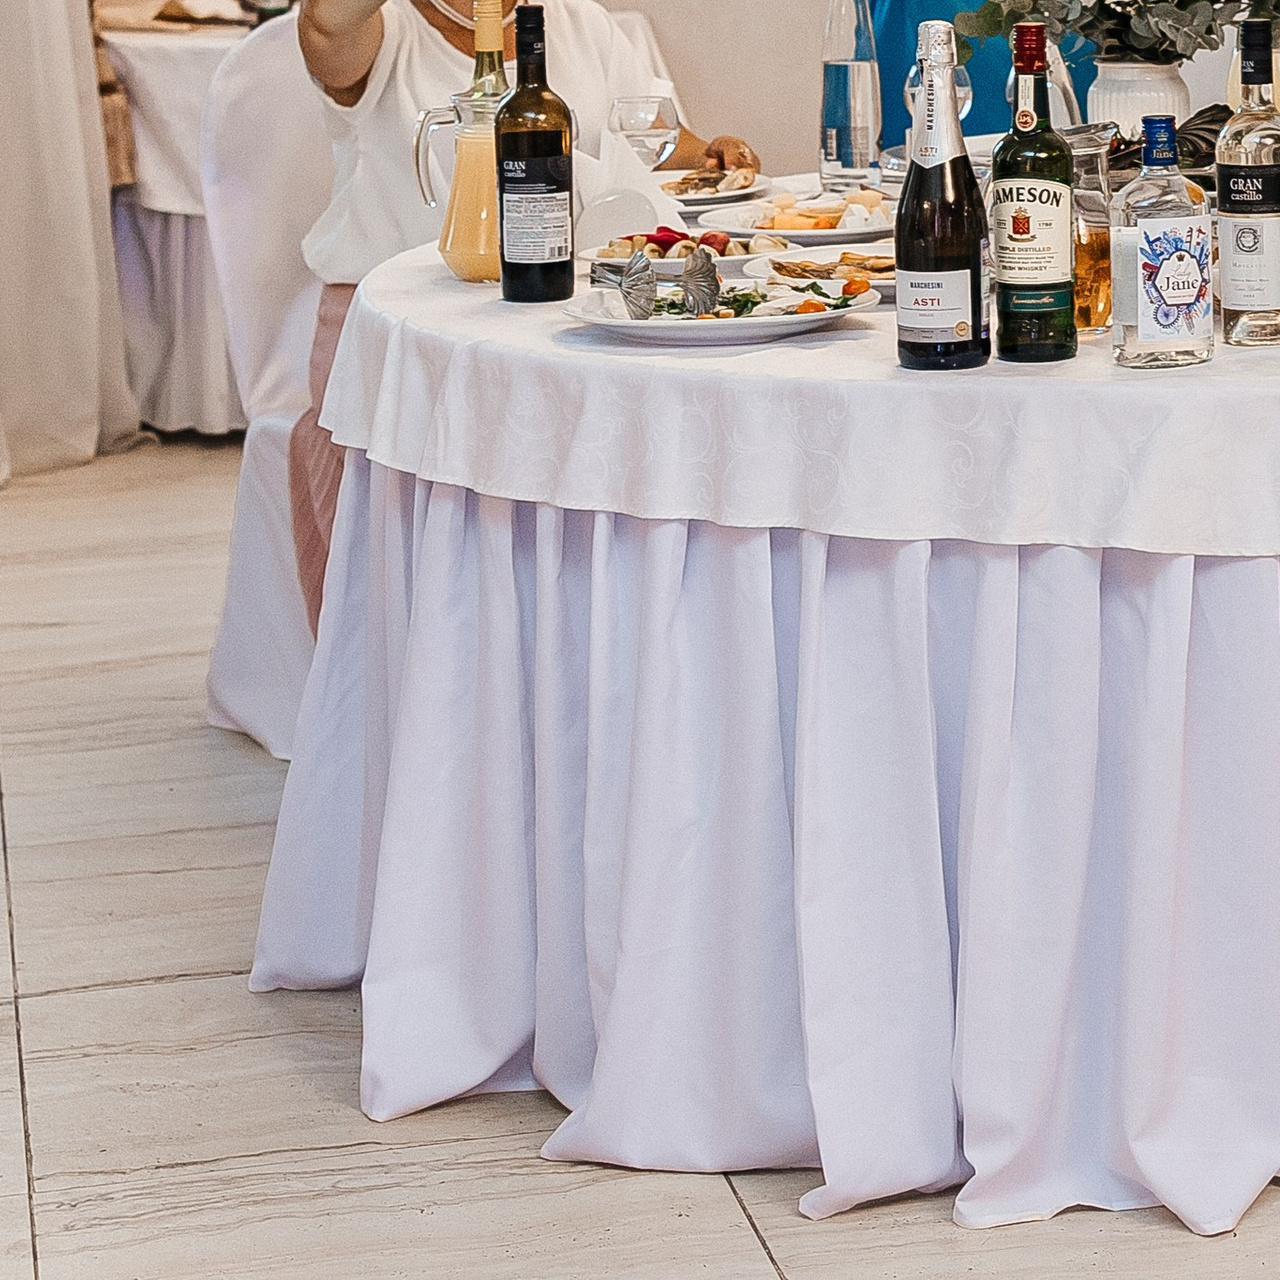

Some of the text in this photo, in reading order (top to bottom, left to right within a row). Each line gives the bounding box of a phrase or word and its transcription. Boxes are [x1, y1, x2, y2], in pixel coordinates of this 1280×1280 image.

[926, 79, 935, 131] MARCHESINI
[503, 161, 526, 170] GRAN
[1229, 178, 1263, 192] GRAN
[1230, 190, 1263, 200] castillo
[1160, 276, 1199, 292] Jane
[913, 297, 941, 307] ASTI
